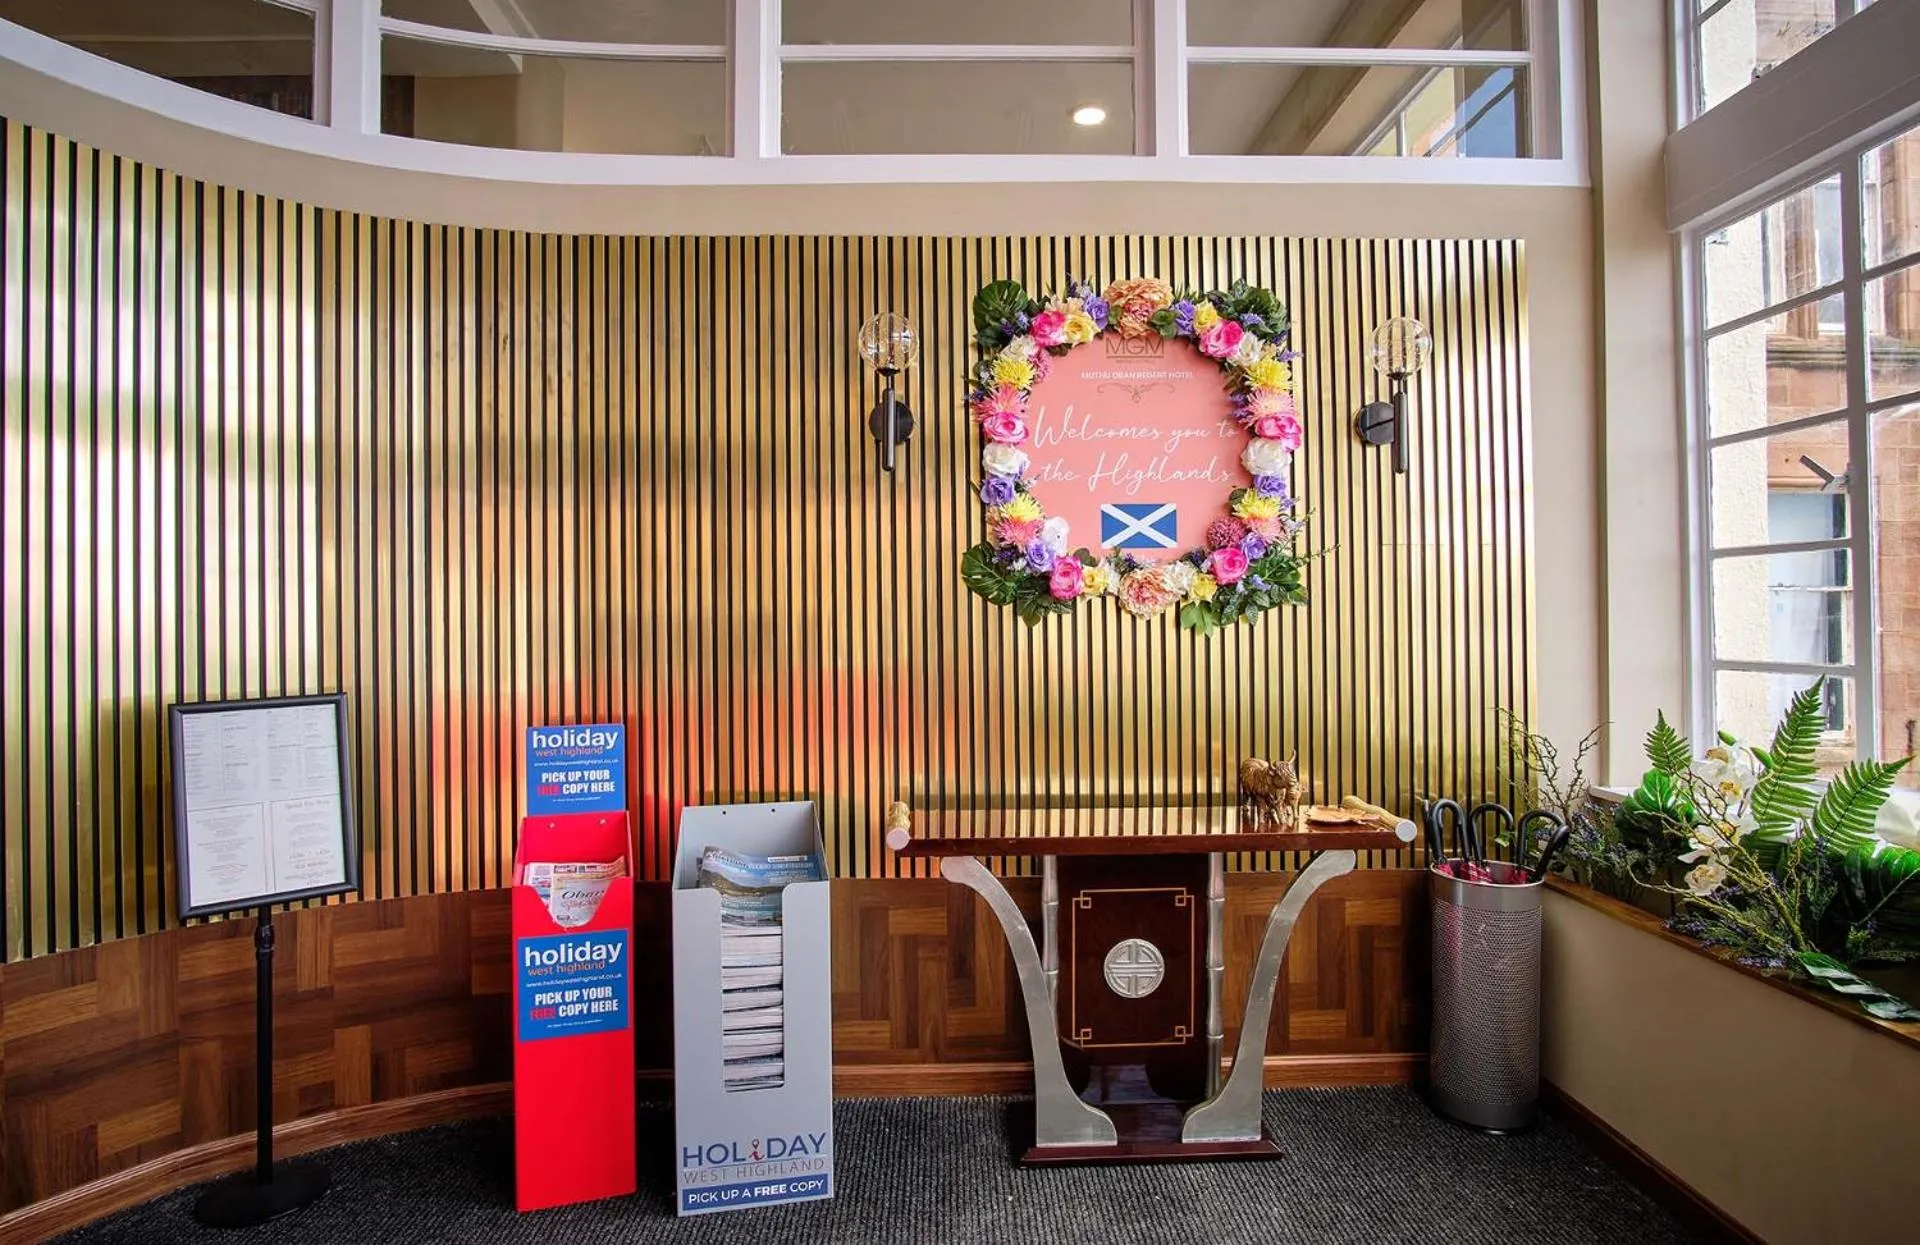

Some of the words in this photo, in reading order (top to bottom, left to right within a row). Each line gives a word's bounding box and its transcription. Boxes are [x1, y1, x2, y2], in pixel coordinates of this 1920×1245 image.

[1106, 338, 1164, 354] MGM
[1034, 404, 1163, 448] Welcomes
[1164, 429, 1211, 453] you
[1217, 421, 1240, 438] to
[1041, 457, 1079, 482] the
[1088, 451, 1233, 496] Highlands
[532, 728, 618, 749] holiday
[535, 749, 558, 758] west
[560, 746, 604, 758] highland
[542, 771, 567, 783] PICK
[567, 771, 582, 782] UP
[583, 769, 611, 781] YOUR
[562, 782, 589, 794] COPY
[591, 781, 616, 792] HERE
[525, 941, 623, 967] holiday
[528, 966, 553, 976] west
[557, 960, 605, 975] highland
[535, 991, 562, 1006] PICK
[564, 989, 580, 1002] UP
[582, 986, 613, 1000] YOUR
[559, 1002, 589, 1017] COPY
[591, 999, 619, 1013] HERE
[683, 1167, 727, 1184] WEST
[736, 1157, 825, 1178] HIGHLAND
[688, 1189, 718, 1204] PICK
[721, 1188, 739, 1200] UP
[742, 1187, 751, 1198] A
[754, 1183, 787, 1197] FREE
[790, 1179, 824, 1192] COPY
